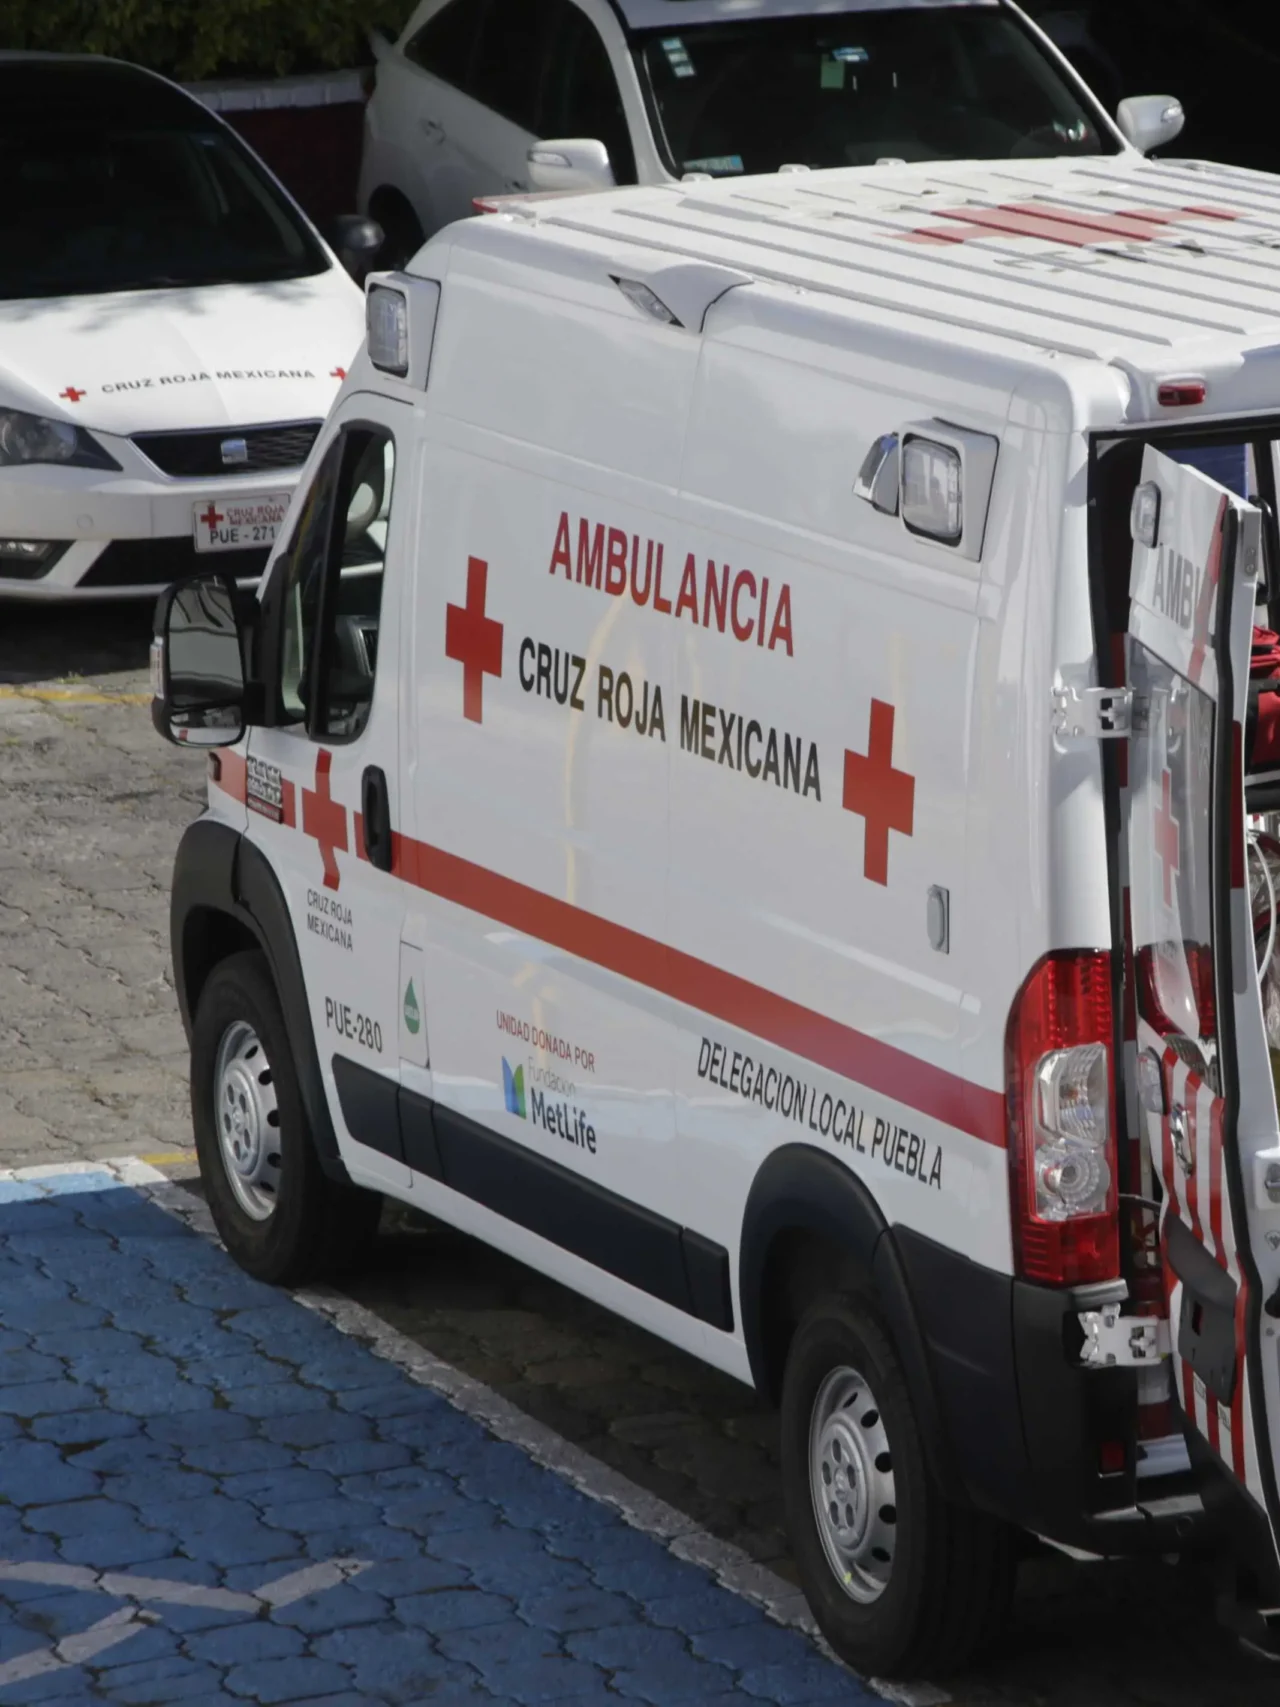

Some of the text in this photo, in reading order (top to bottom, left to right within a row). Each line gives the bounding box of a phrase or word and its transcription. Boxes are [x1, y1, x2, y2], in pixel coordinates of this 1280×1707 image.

[101, 369, 316, 394] CRUZ ROJA MEXICANA
[549, 510, 794, 657] AMBULANCIA
[518, 636, 822, 802] CRUZ ROJA MEXICANA
[307, 888, 353, 927] CRUZ ROJA
[307, 913, 353, 951] MEXICANA
[325, 996, 382, 1053] PUE-280
[496, 1009, 595, 1073] UNIDAD DONADA POR
[531, 1086, 597, 1154] MetLife
[697, 1037, 943, 1190] DELEGACION LOCAL PUEBLA
